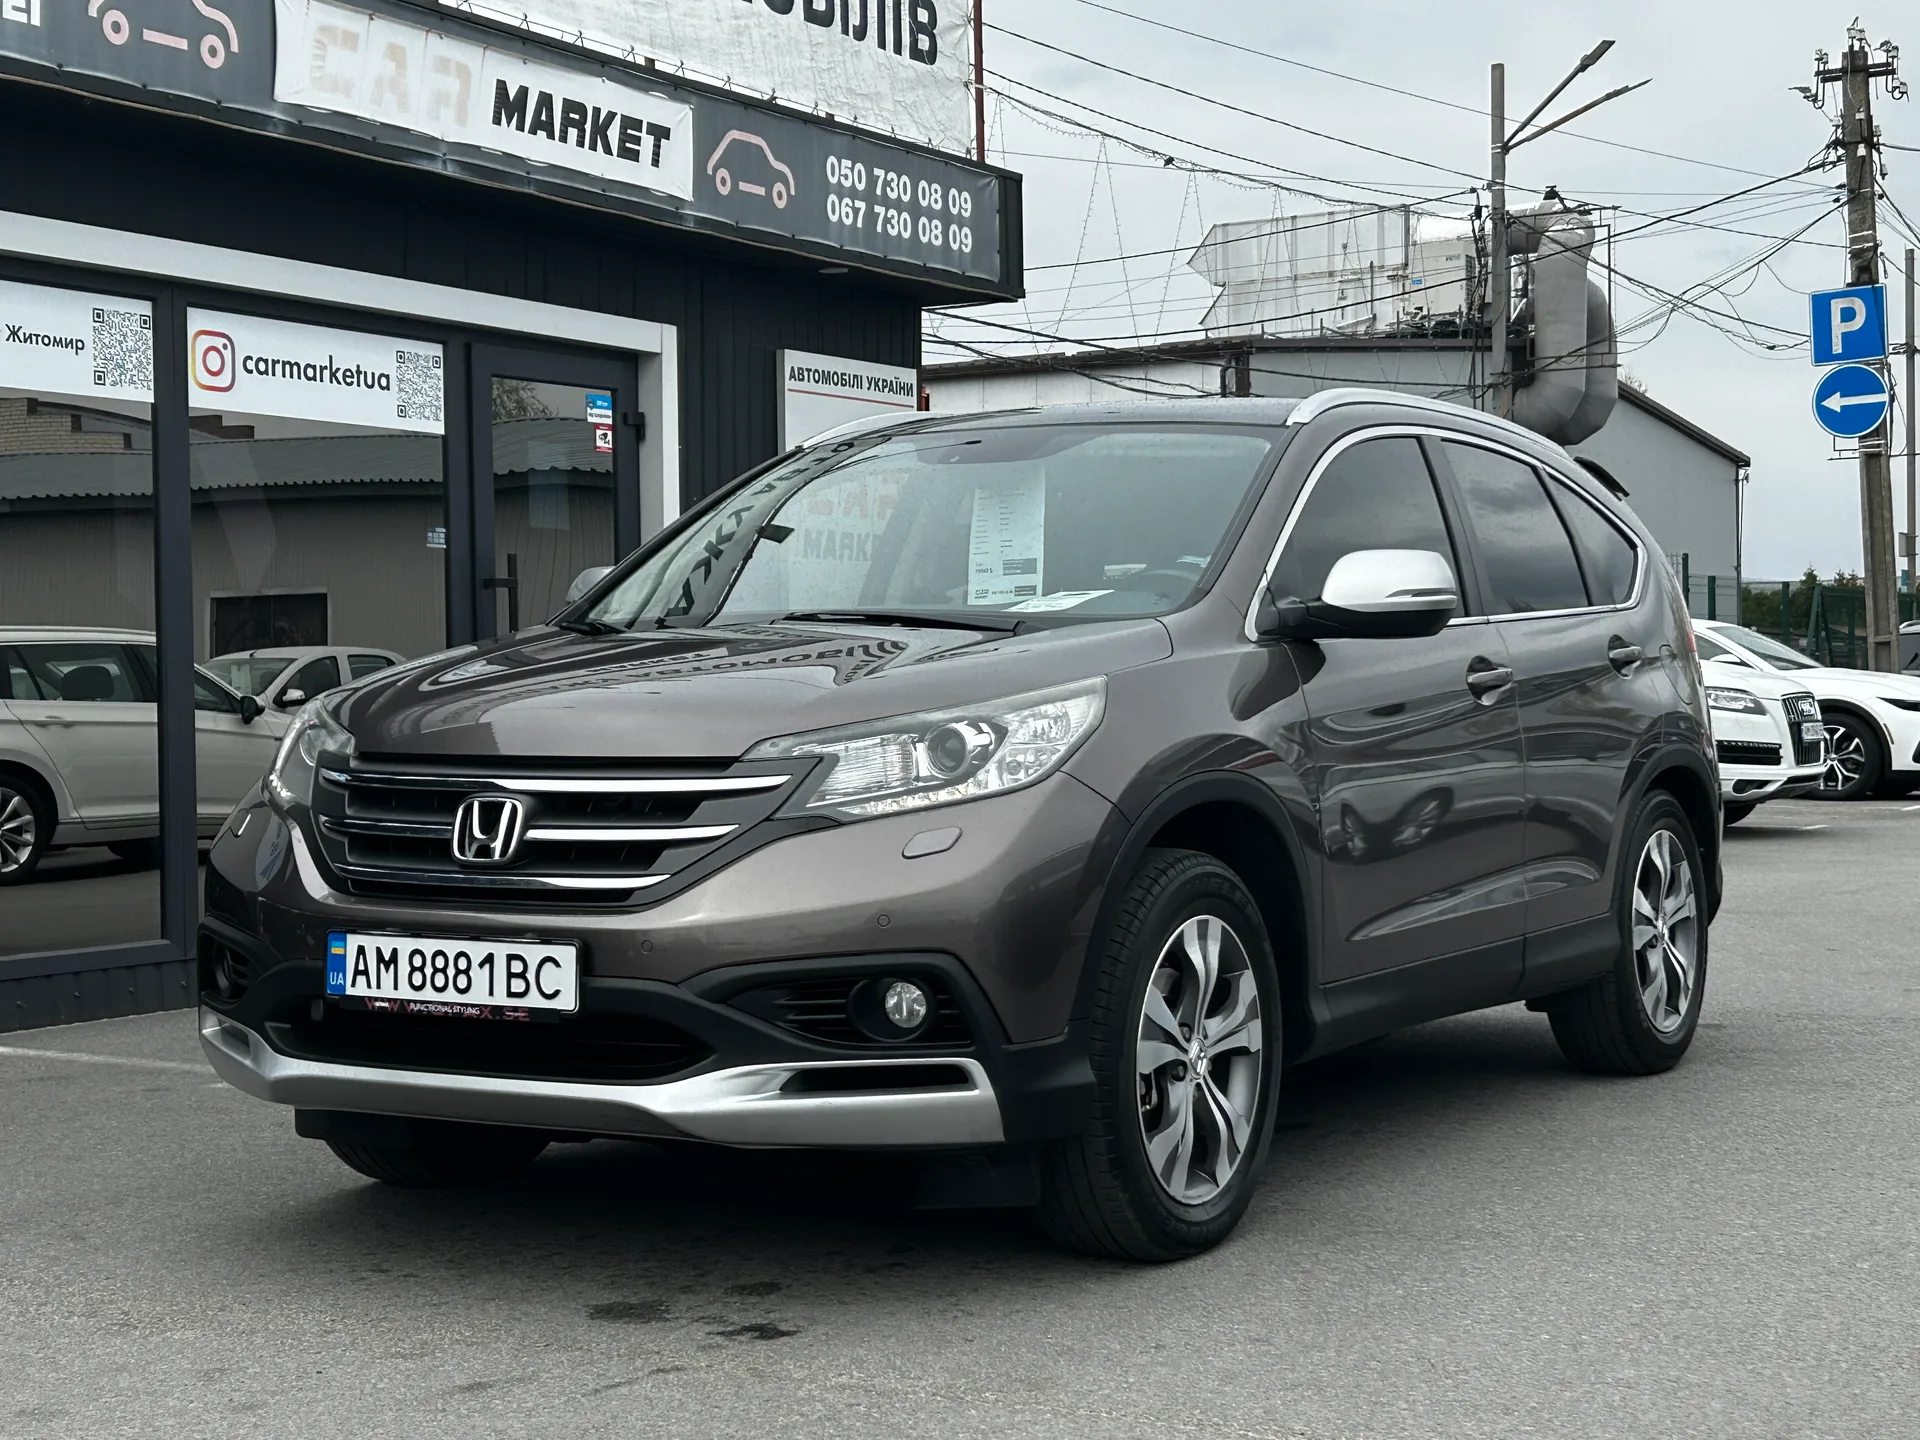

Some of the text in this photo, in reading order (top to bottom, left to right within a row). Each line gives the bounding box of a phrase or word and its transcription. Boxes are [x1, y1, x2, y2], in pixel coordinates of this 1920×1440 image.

[310, 25, 671, 169] CAR MARKET
[826, 155, 972, 218] 050 730 08 09
[826, 193, 972, 253] 067 730 08 09
[5, 323, 85, 356] Житомир
[1830, 297, 1866, 354] P
[242, 354, 391, 391] carmarketua
[788, 366, 914, 397] АВТОМОБІЛІ УКРАЇНИ
[329, 971, 345, 986] UA
